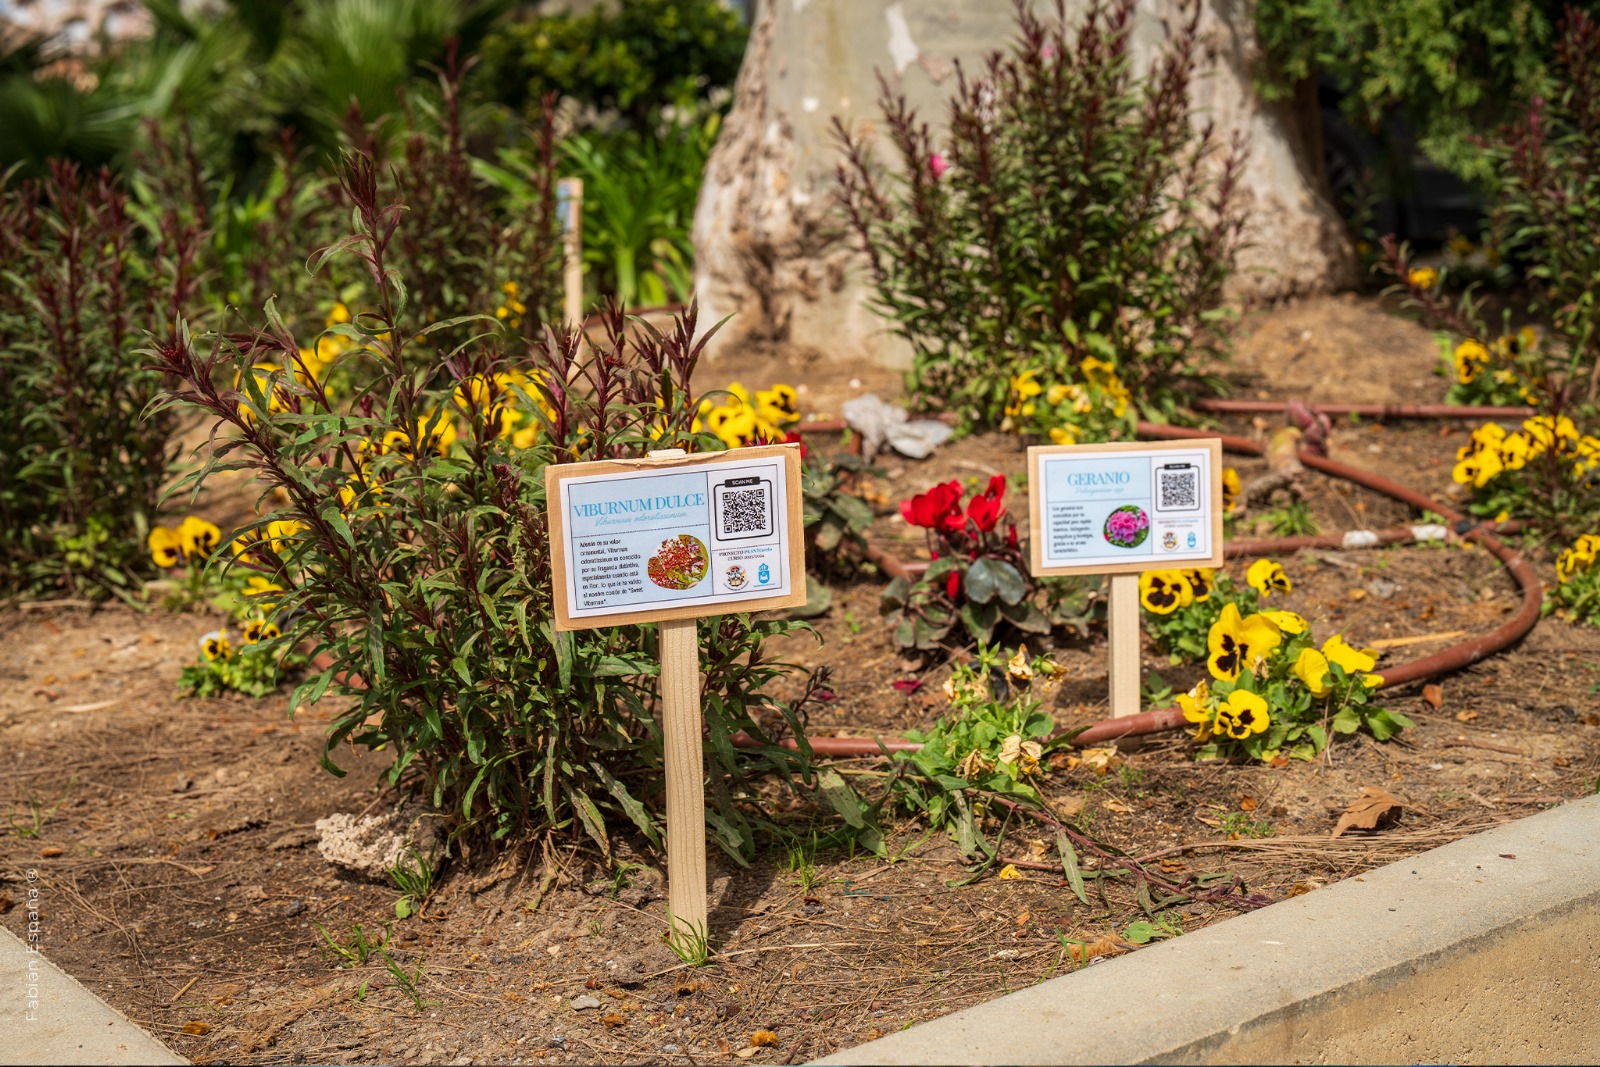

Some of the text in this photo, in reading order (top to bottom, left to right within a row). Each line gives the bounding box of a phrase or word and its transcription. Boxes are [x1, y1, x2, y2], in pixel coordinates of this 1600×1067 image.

[1067, 471, 1130, 486] GERANIO
[574, 493, 705, 517] VIBURNUM DULCE
[595, 512, 687, 526] Viburnum odoratissimum
